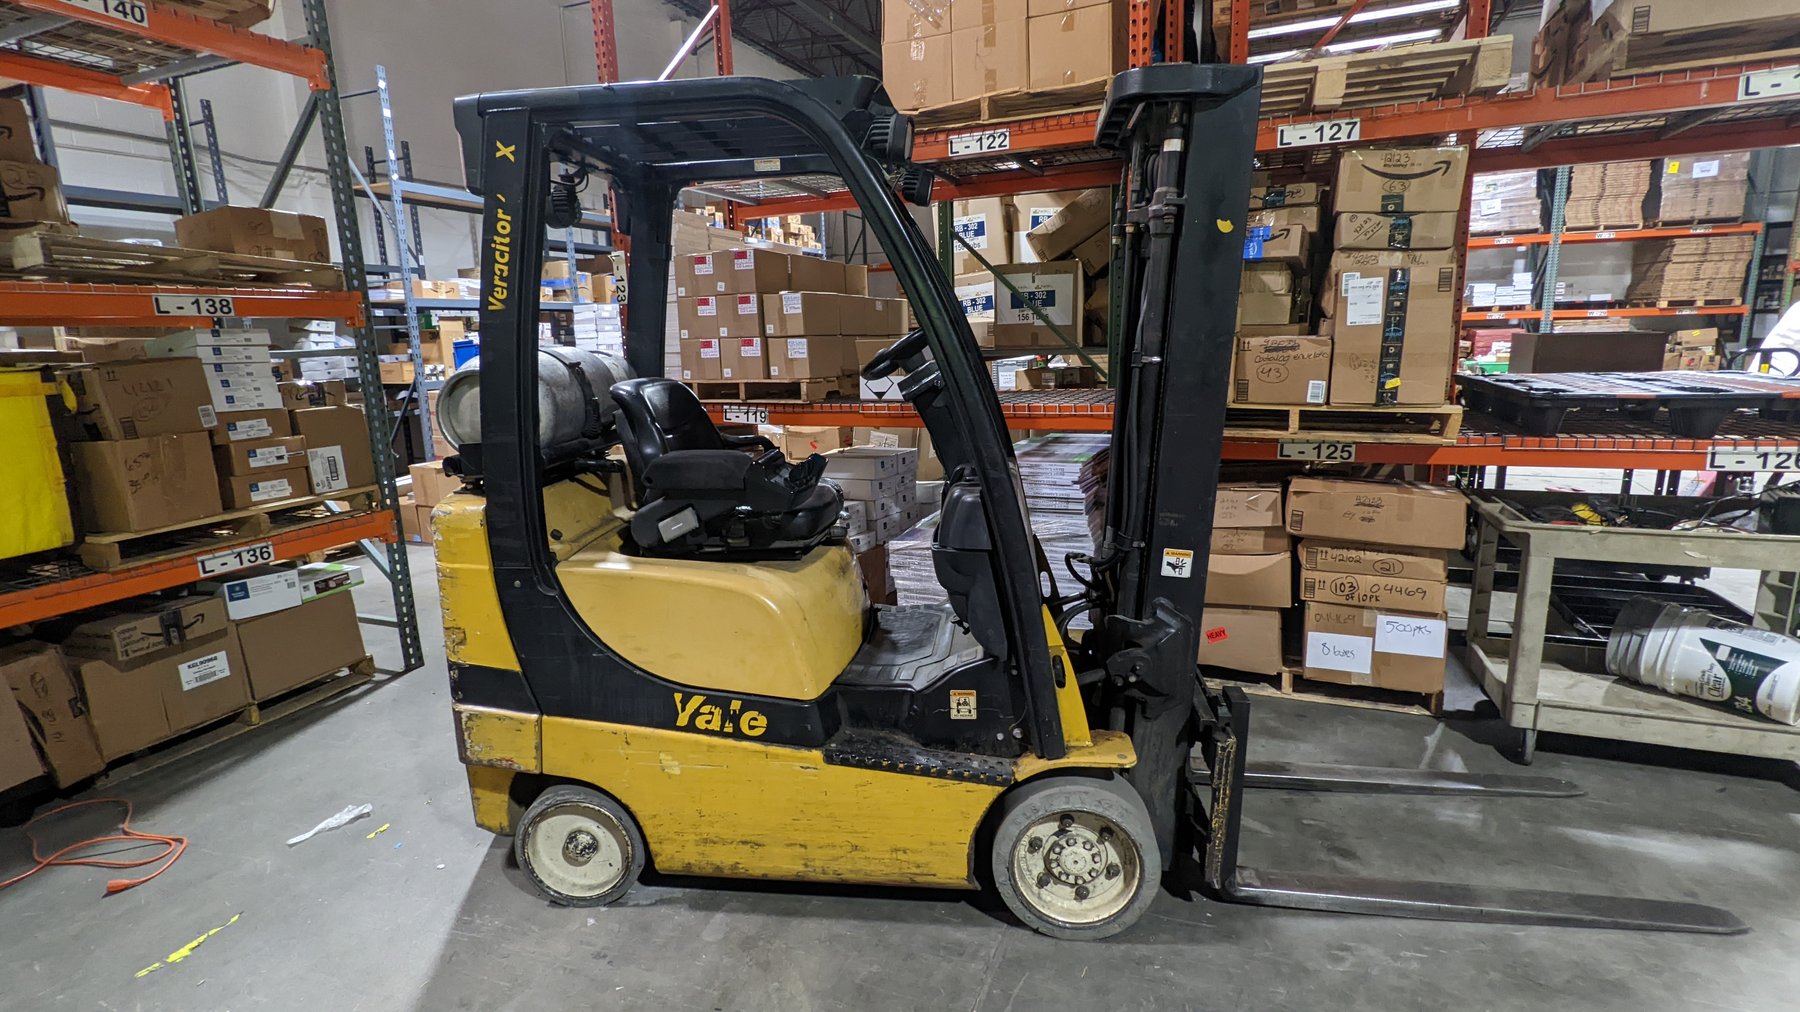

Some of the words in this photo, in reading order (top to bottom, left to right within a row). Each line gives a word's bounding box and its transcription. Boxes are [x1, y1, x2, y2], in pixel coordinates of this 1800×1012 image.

[1745, 76, 1760, 96] L
[1280, 129, 1292, 146] L
[1315, 121, 1358, 142] 127
[950, 140, 959, 154] L
[976, 132, 1007, 151] 122
[967, 222, 978, 230] 302
[488, 209, 512, 311] Veracitor
[616, 276, 626, 303] 123
[1034, 291, 1047, 299] 302
[155, 297, 171, 314] L
[191, 298, 232, 315] 138
[967, 304, 983, 312] BLUE
[1018, 313, 1029, 321] 156
[1260, 367, 1282, 378] 43
[725, 409, 732, 420] L
[744, 409, 767, 423] 119
[1279, 444, 1291, 458] L
[1312, 444, 1353, 460] 125
[1709, 452, 1726, 468] L
[201, 560, 215, 575] L
[233, 545, 272, 567] 136
[1380, 562, 1395, 572] 21
[1335, 585, 1356, 593] 103
[1370, 584, 1427, 600] 04469
[1206, 630, 1226, 640] HEAVY
[674, 692, 768, 736] Yale
